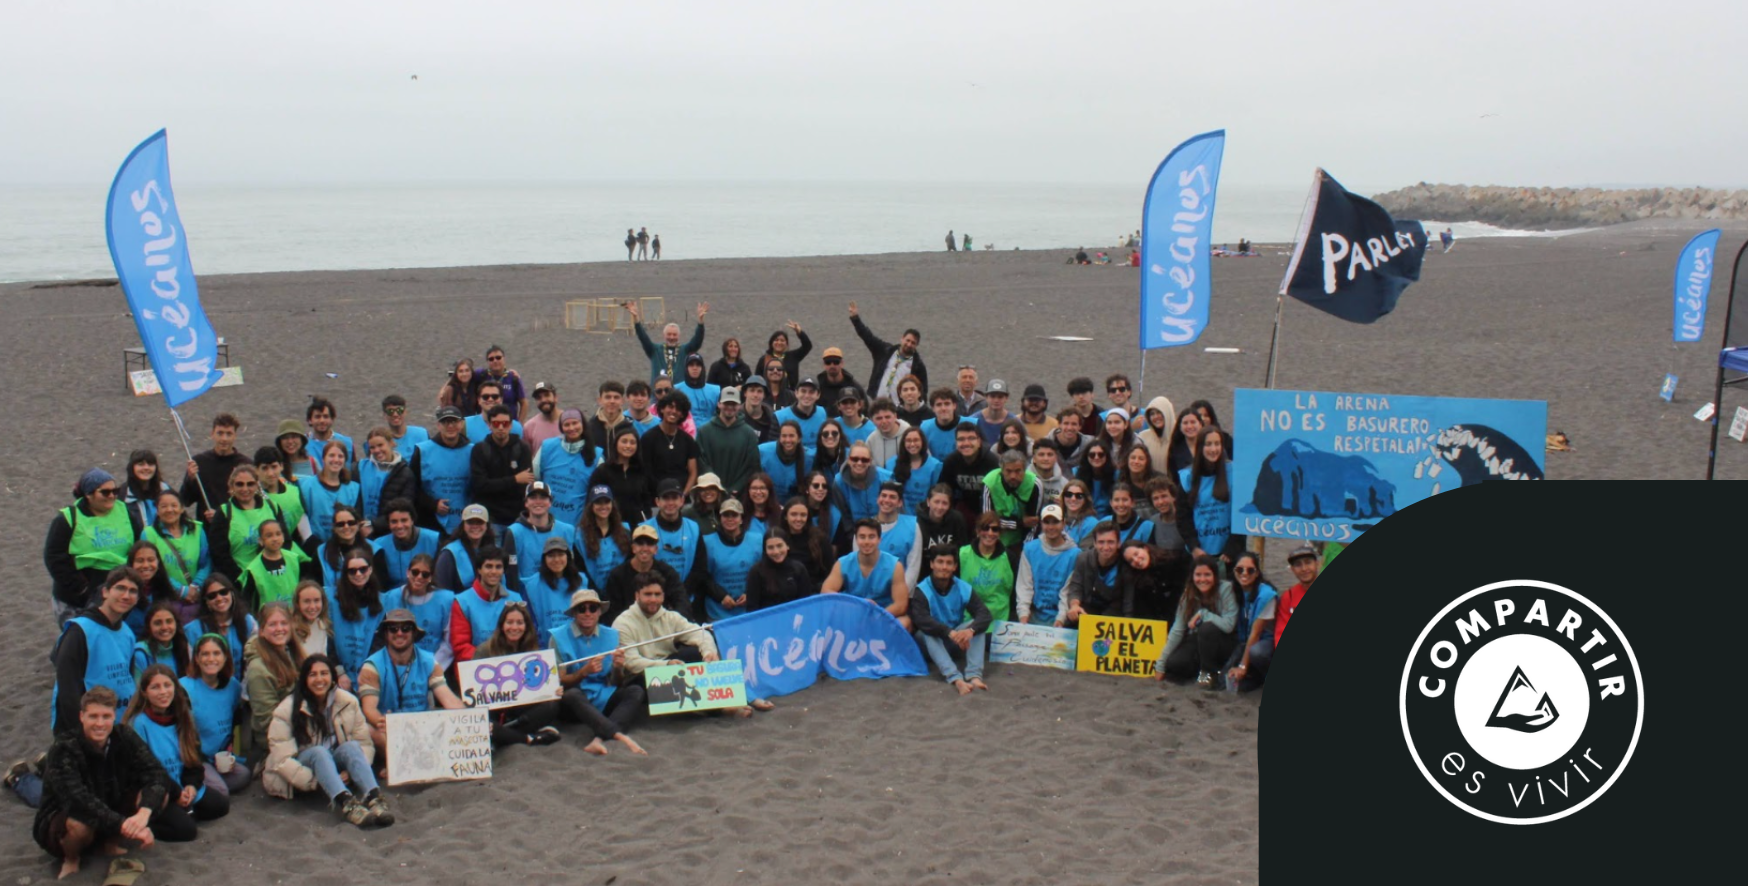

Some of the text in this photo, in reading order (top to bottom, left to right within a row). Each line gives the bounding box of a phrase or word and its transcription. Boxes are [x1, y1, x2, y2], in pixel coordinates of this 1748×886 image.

[1151, 163, 1210, 343] ucéanos
[1320, 230, 1415, 294] PARLEY
[130, 179, 213, 392] ucéanos
[1679, 247, 1711, 340] ucéanos
[1295, 394, 1390, 411] LA ARENA
[1260, 409, 1430, 435] NO ES BASURERO
[1244, 516, 1352, 541] ucéanos
[1094, 621, 1155, 645] SALVA
[1118, 642, 1139, 657] EL
[686, 664, 704, 676] TU
[1095, 656, 1157, 676] PLANETA
[707, 687, 734, 701] SOLA
[449, 713, 487, 725] VIGILA
[454, 725, 481, 735] A TU
[448, 747, 491, 760] CUIDA LA
[451, 760, 492, 778] FAUNA
